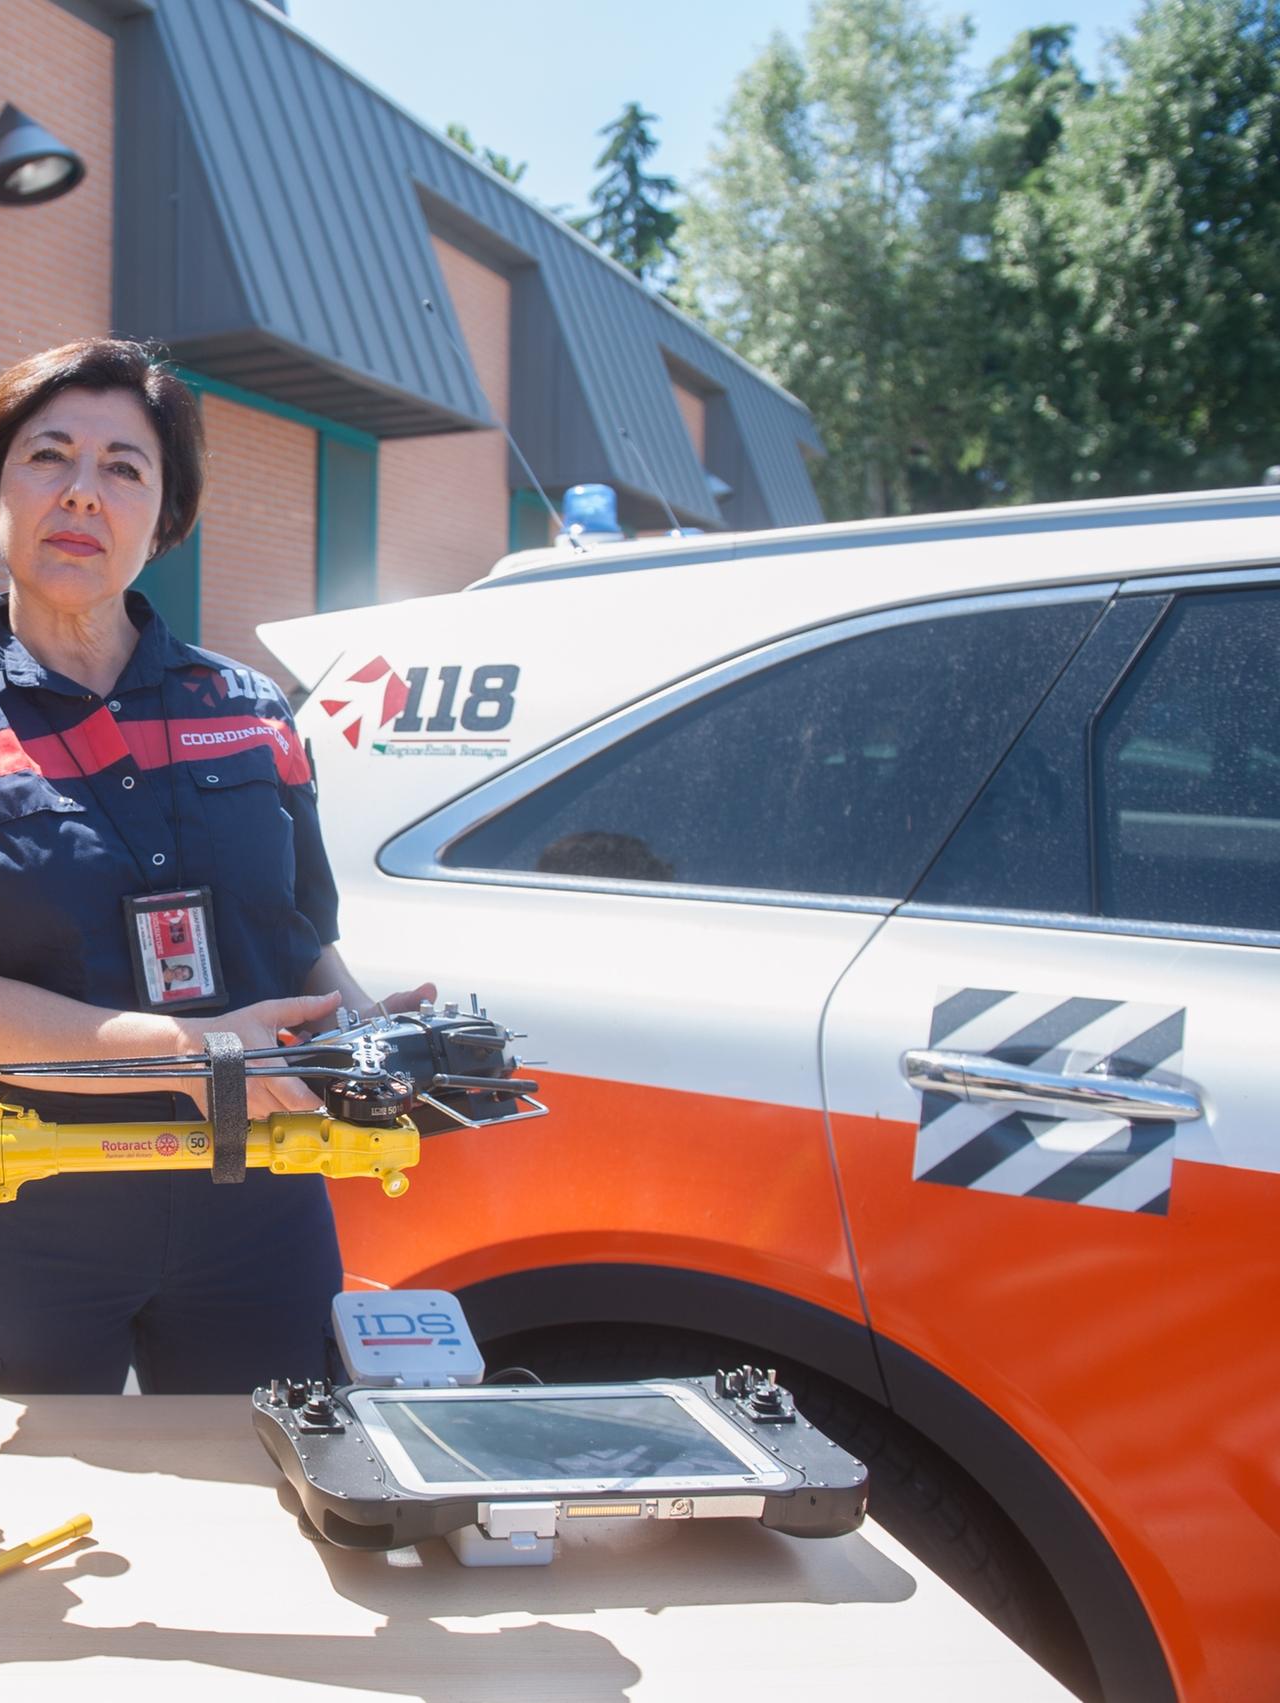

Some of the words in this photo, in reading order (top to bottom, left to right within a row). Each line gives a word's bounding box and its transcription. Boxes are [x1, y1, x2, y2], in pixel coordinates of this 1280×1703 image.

[220, 669, 279, 701] 118
[393, 664, 520, 732] 118
[102, 1140, 152, 1151] Rotaract
[352, 1313, 455, 1336] IDS
